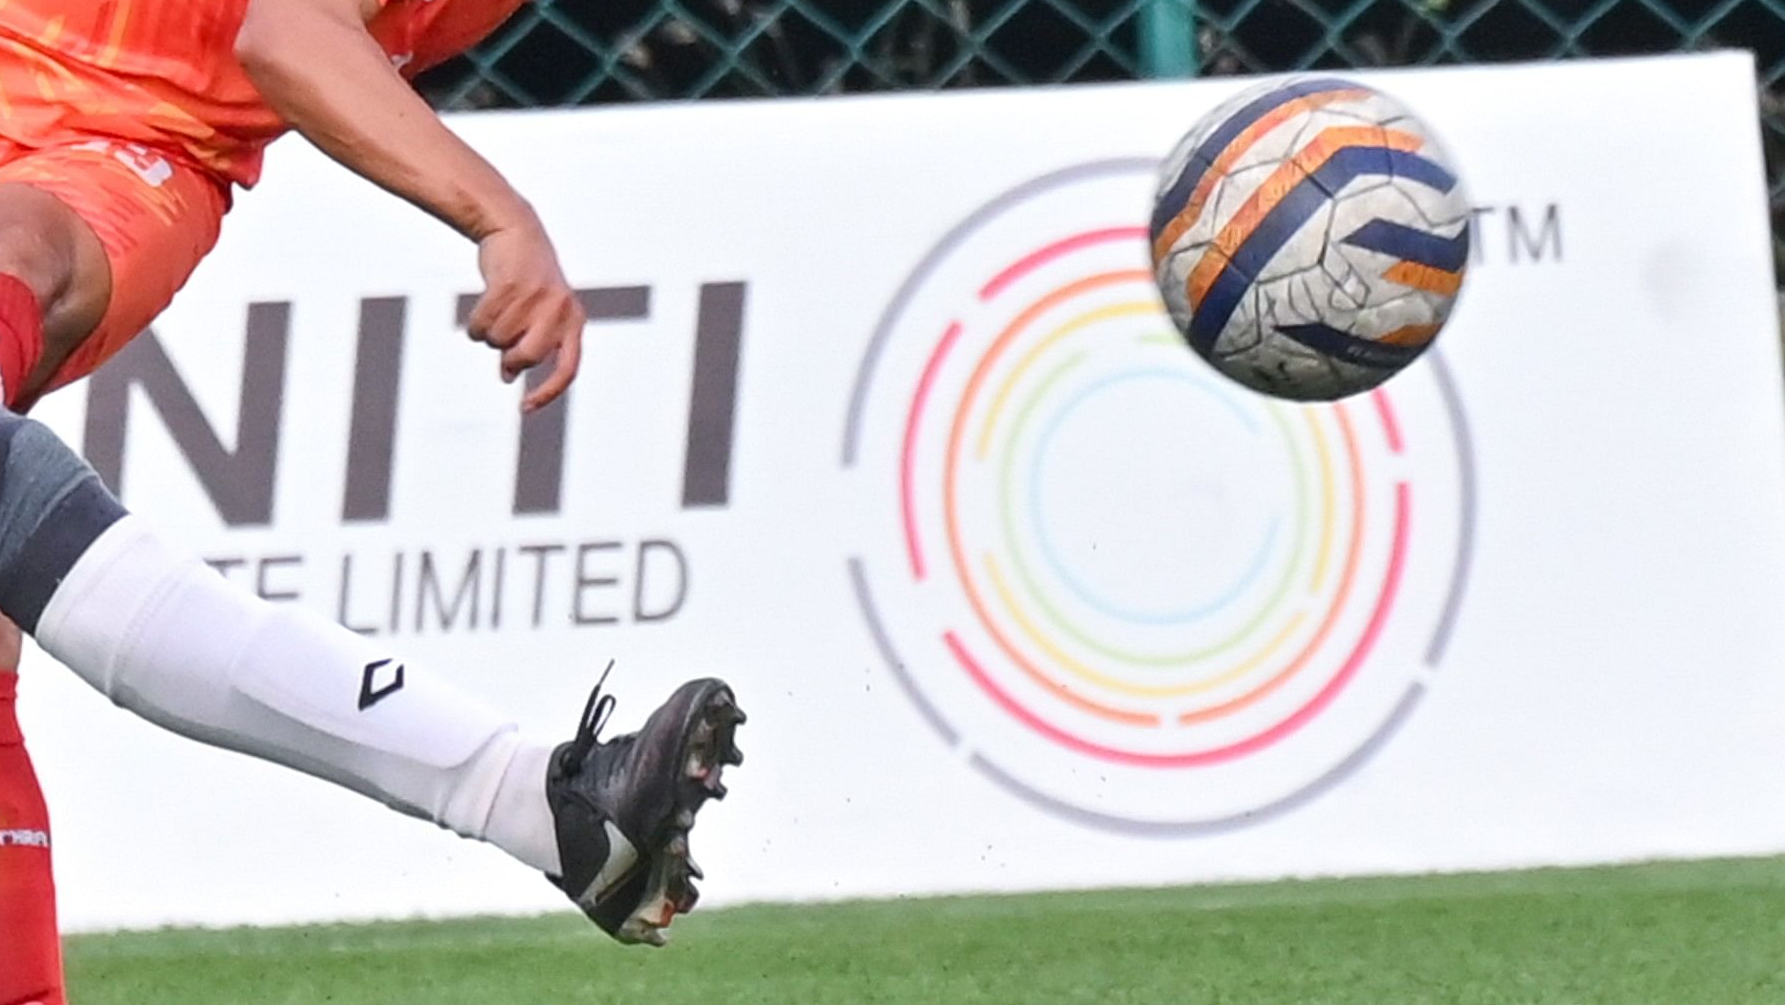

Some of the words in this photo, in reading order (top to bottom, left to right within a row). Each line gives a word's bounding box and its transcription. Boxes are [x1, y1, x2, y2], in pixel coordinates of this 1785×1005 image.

[1467, 202, 1562, 267] TM
[81, 280, 748, 527] NITI
[336, 538, 690, 636] LIMITED
